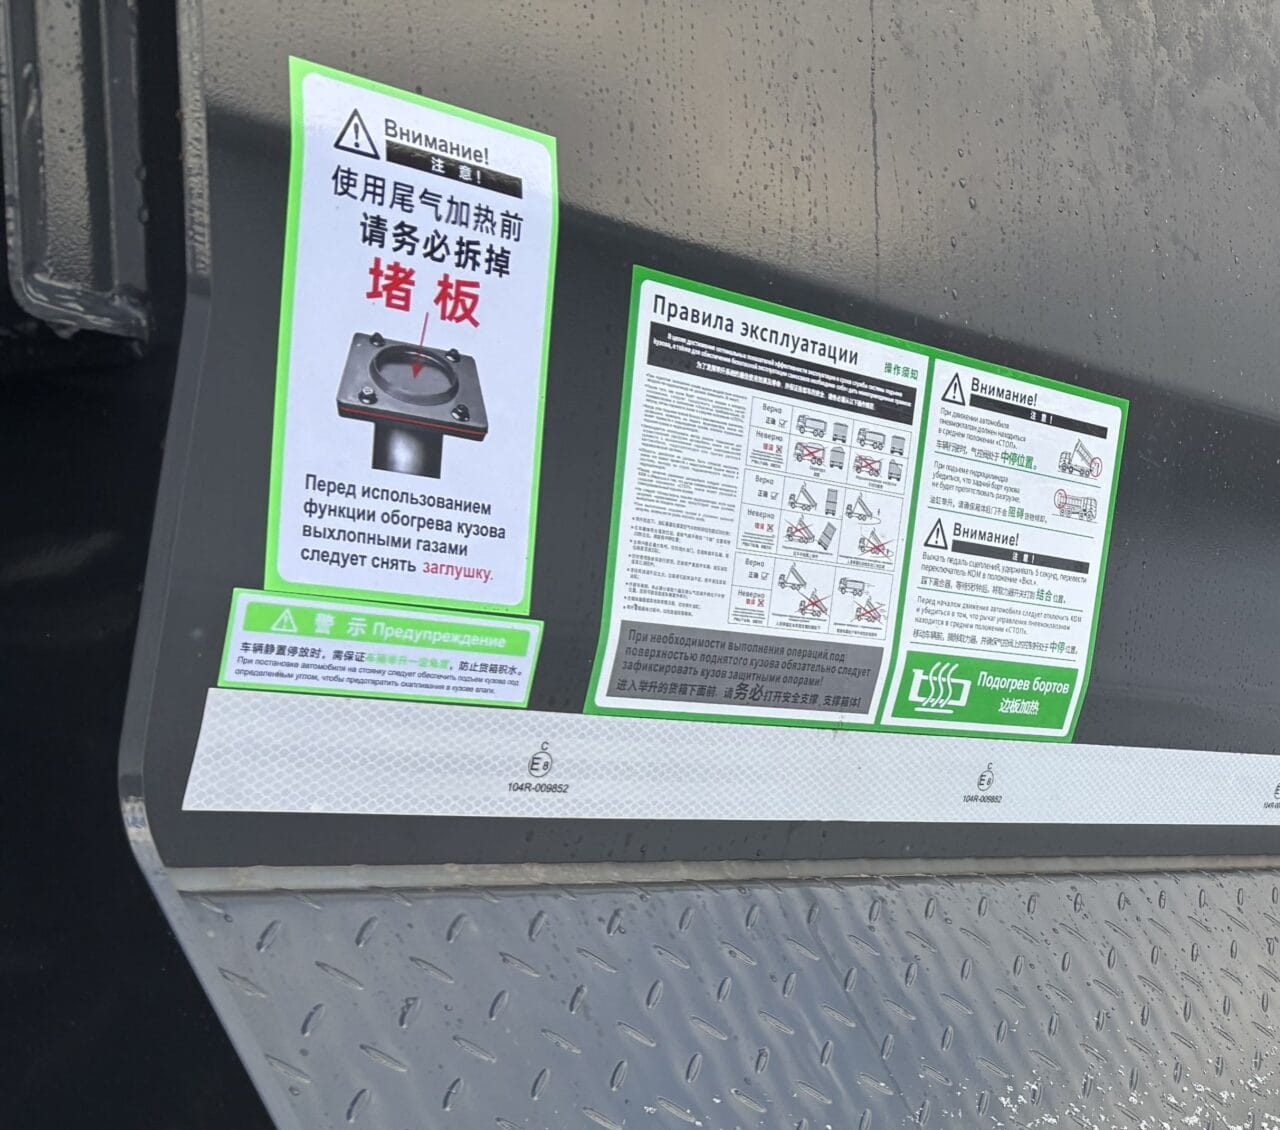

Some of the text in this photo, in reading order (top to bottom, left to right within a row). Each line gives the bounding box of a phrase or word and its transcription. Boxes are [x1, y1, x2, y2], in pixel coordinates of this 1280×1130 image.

[384, 118, 489, 165] Внимание!
[331, 165, 523, 242] 使用尾气加热前
[360, 212, 511, 278] 请务必拆掉
[366, 256, 480, 327] 堵板
[653, 294, 734, 334] Правила
[740, 321, 859, 366] эксплуатации
[971, 377, 1038, 406] Внимание!
[762, 403, 782, 414] Верно
[305, 473, 492, 515] Перед использованием
[754, 475, 774, 485] Верно
[304, 498, 506, 539] функции обогрева кузова
[953, 522, 1019, 546] Внимание!
[302, 524, 468, 556] выхлопными газами
[301, 547, 494, 584] следует снять заглушку.
[372, 622, 506, 650] Предупреждение
[628, 629, 846, 662] При необходимости выполнения операций под
[237, 655, 254, 665] При
[622, 658, 824, 688] зафиксировать кузов защитными опорами!
[625, 646, 871, 678] поверхностью поднятого кузова обязательно следует
[977, 671, 1070, 696] Подогрев бортов
[541, 741, 550, 751] C
[508, 782, 570, 794] 104R-009852
